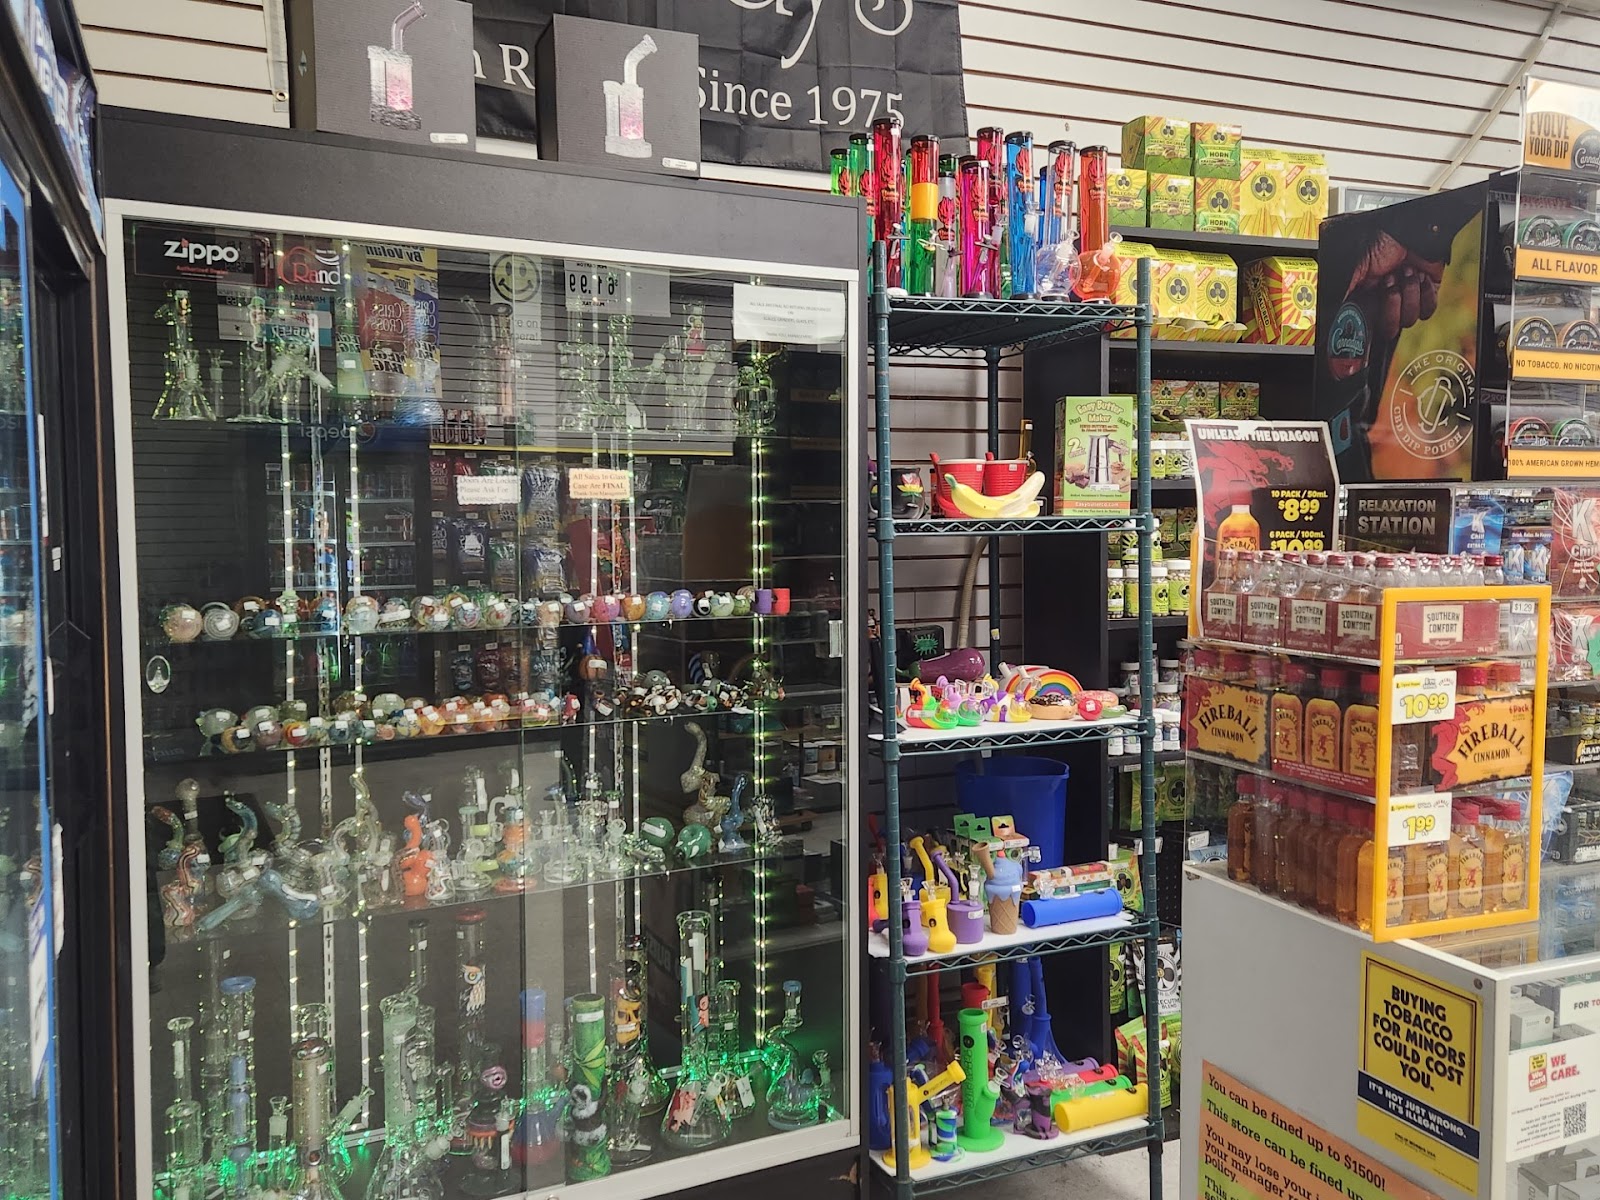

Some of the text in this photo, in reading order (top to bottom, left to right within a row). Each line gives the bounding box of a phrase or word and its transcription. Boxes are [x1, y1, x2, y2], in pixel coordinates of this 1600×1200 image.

[807, 85, 905, 127] 1975
[1530, 113, 1569, 140] EVOLVE
[1530, 136, 1569, 160] YOUR DIP
[1531, 258, 1598, 275] ALL FLAVOR
[1516, 359, 1526, 367] NO
[1563, 361, 1573, 370] NO
[1407, 354, 1475, 404] THE ORIGINAL
[1076, 399, 1124, 415] Easy Butter
[1087, 414, 1111, 423] Maker
[1272, 430, 1319, 442] DRAGON
[1394, 406, 1463, 455] CBD DIP POUCH
[1525, 459, 1559, 467] AMERICAN
[1358, 499, 1436, 513] RELAXATION
[1358, 516, 1436, 535] STATION
[1341, 609, 1373, 620] SOUTHERN
[1514, 603, 1532, 611] $1.29
[1343, 619, 1371, 631] COMFORT
[1427, 611, 1460, 622] SOUTHERN
[1429, 622, 1457, 633] COMFORT
[1249, 695, 1264, 706] Pack
[1513, 704, 1530, 714] Pack
[1199, 704, 1259, 740] FIREBALL
[1211, 727, 1244, 743] CINNAMON
[1458, 722, 1525, 759] FIREBALL
[1473, 748, 1510, 763] CINNAMON
[1391, 985, 1447, 1022] BUYING
[1573, 1001, 1590, 1010] FOR
[1383, 999, 1453, 1042] TOBACCO
[1372, 1013, 1466, 1068] FOR MINORS
[1373, 1032, 1464, 1086] COULD COST
[1550, 1054, 1567, 1068] WE
[1400, 1060, 1435, 1092] YOU.
[1529, 1075, 1546, 1088] Card
[1531, 1070, 1545, 1080] We
[1551, 1064, 1580, 1081] CARE.
[1368, 1080, 1467, 1138] IT'S NOT JUST WRONG.
[1388, 1100, 1444, 1137] IT'S ILLEGAL.
[1208, 1073, 1386, 1191] You can be fined up to $1500!
[1207, 1098, 1229, 1123] This
[1231, 1118, 1261, 1142] store
[1264, 1138, 1287, 1158] can
[1290, 1147, 1306, 1169] be
[1309, 1161, 1343, 1194] fined
[1204, 1153, 1239, 1183] policy.
[1204, 1140, 1285, 1198] your manager
[1205, 1123, 1313, 1200] You may lose your
[1204, 1175, 1227, 1199] This
